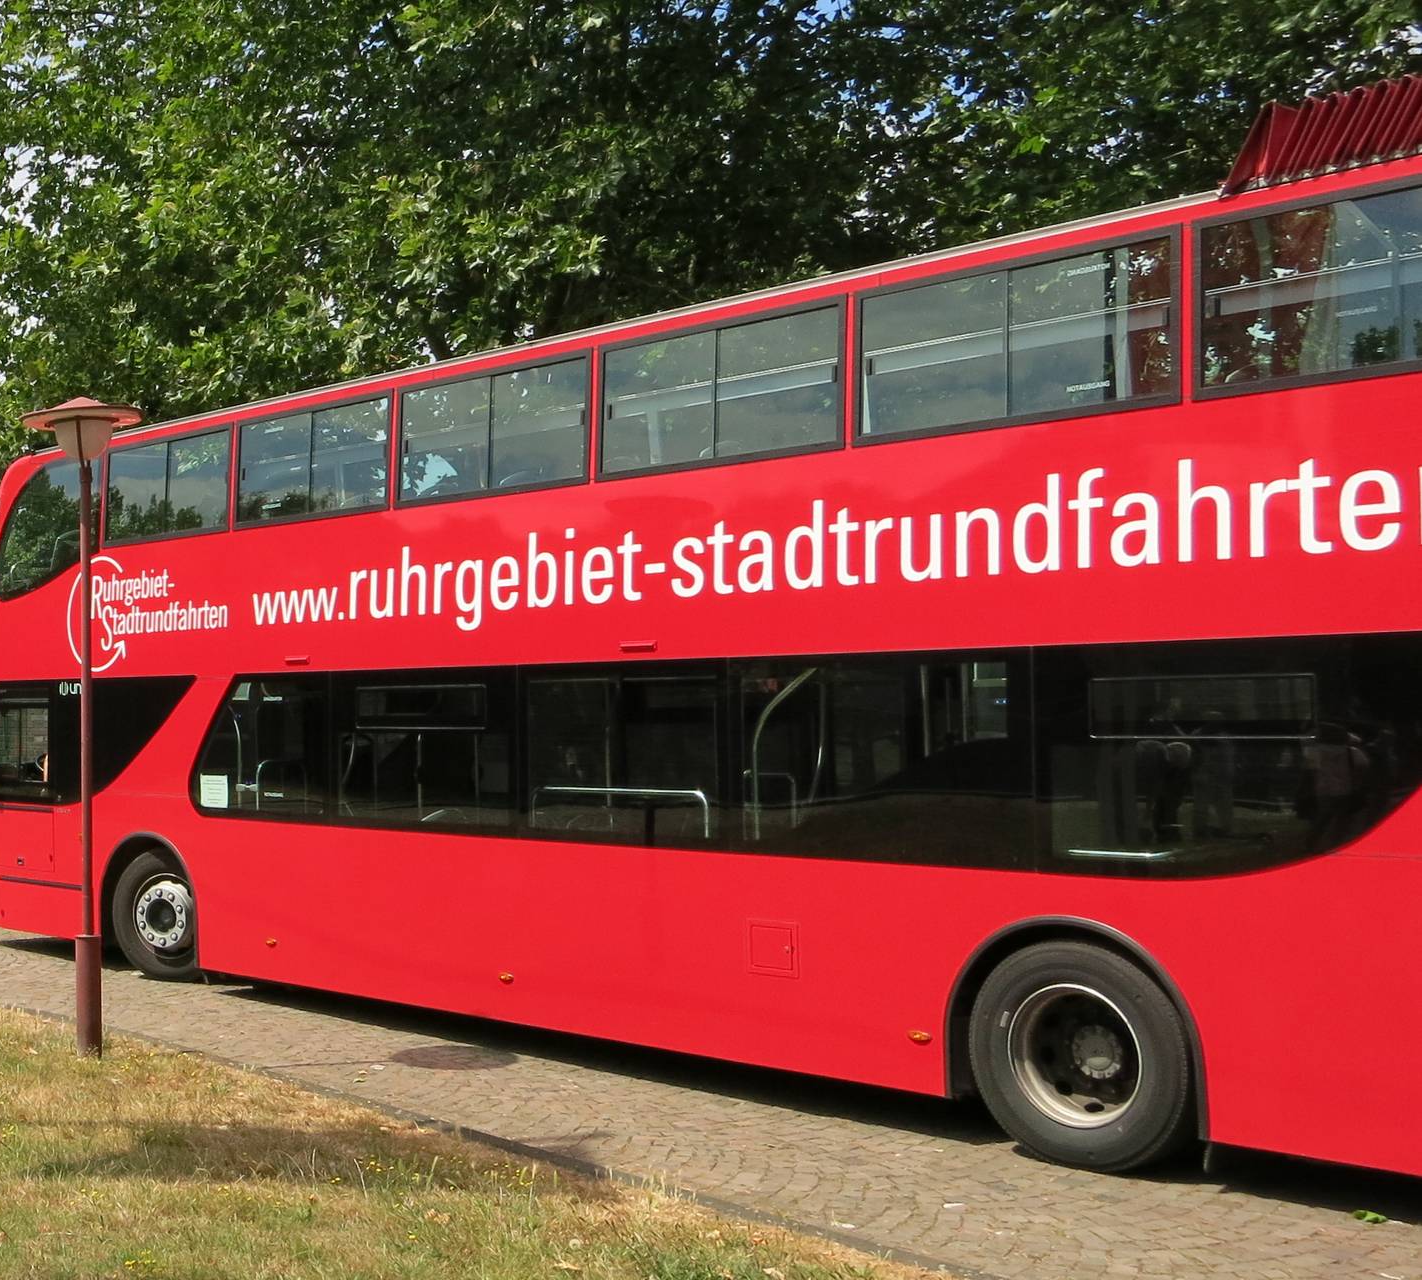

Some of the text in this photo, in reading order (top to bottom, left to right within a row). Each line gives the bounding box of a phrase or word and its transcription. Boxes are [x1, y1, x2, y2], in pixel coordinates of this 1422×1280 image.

[252, 457, 1422, 632] www.ruhrgebiet-stadtrundfahrte
[90, 568, 176, 620] Ruhrgebiet-
[100, 599, 229, 652] Stadtrundfahrten
